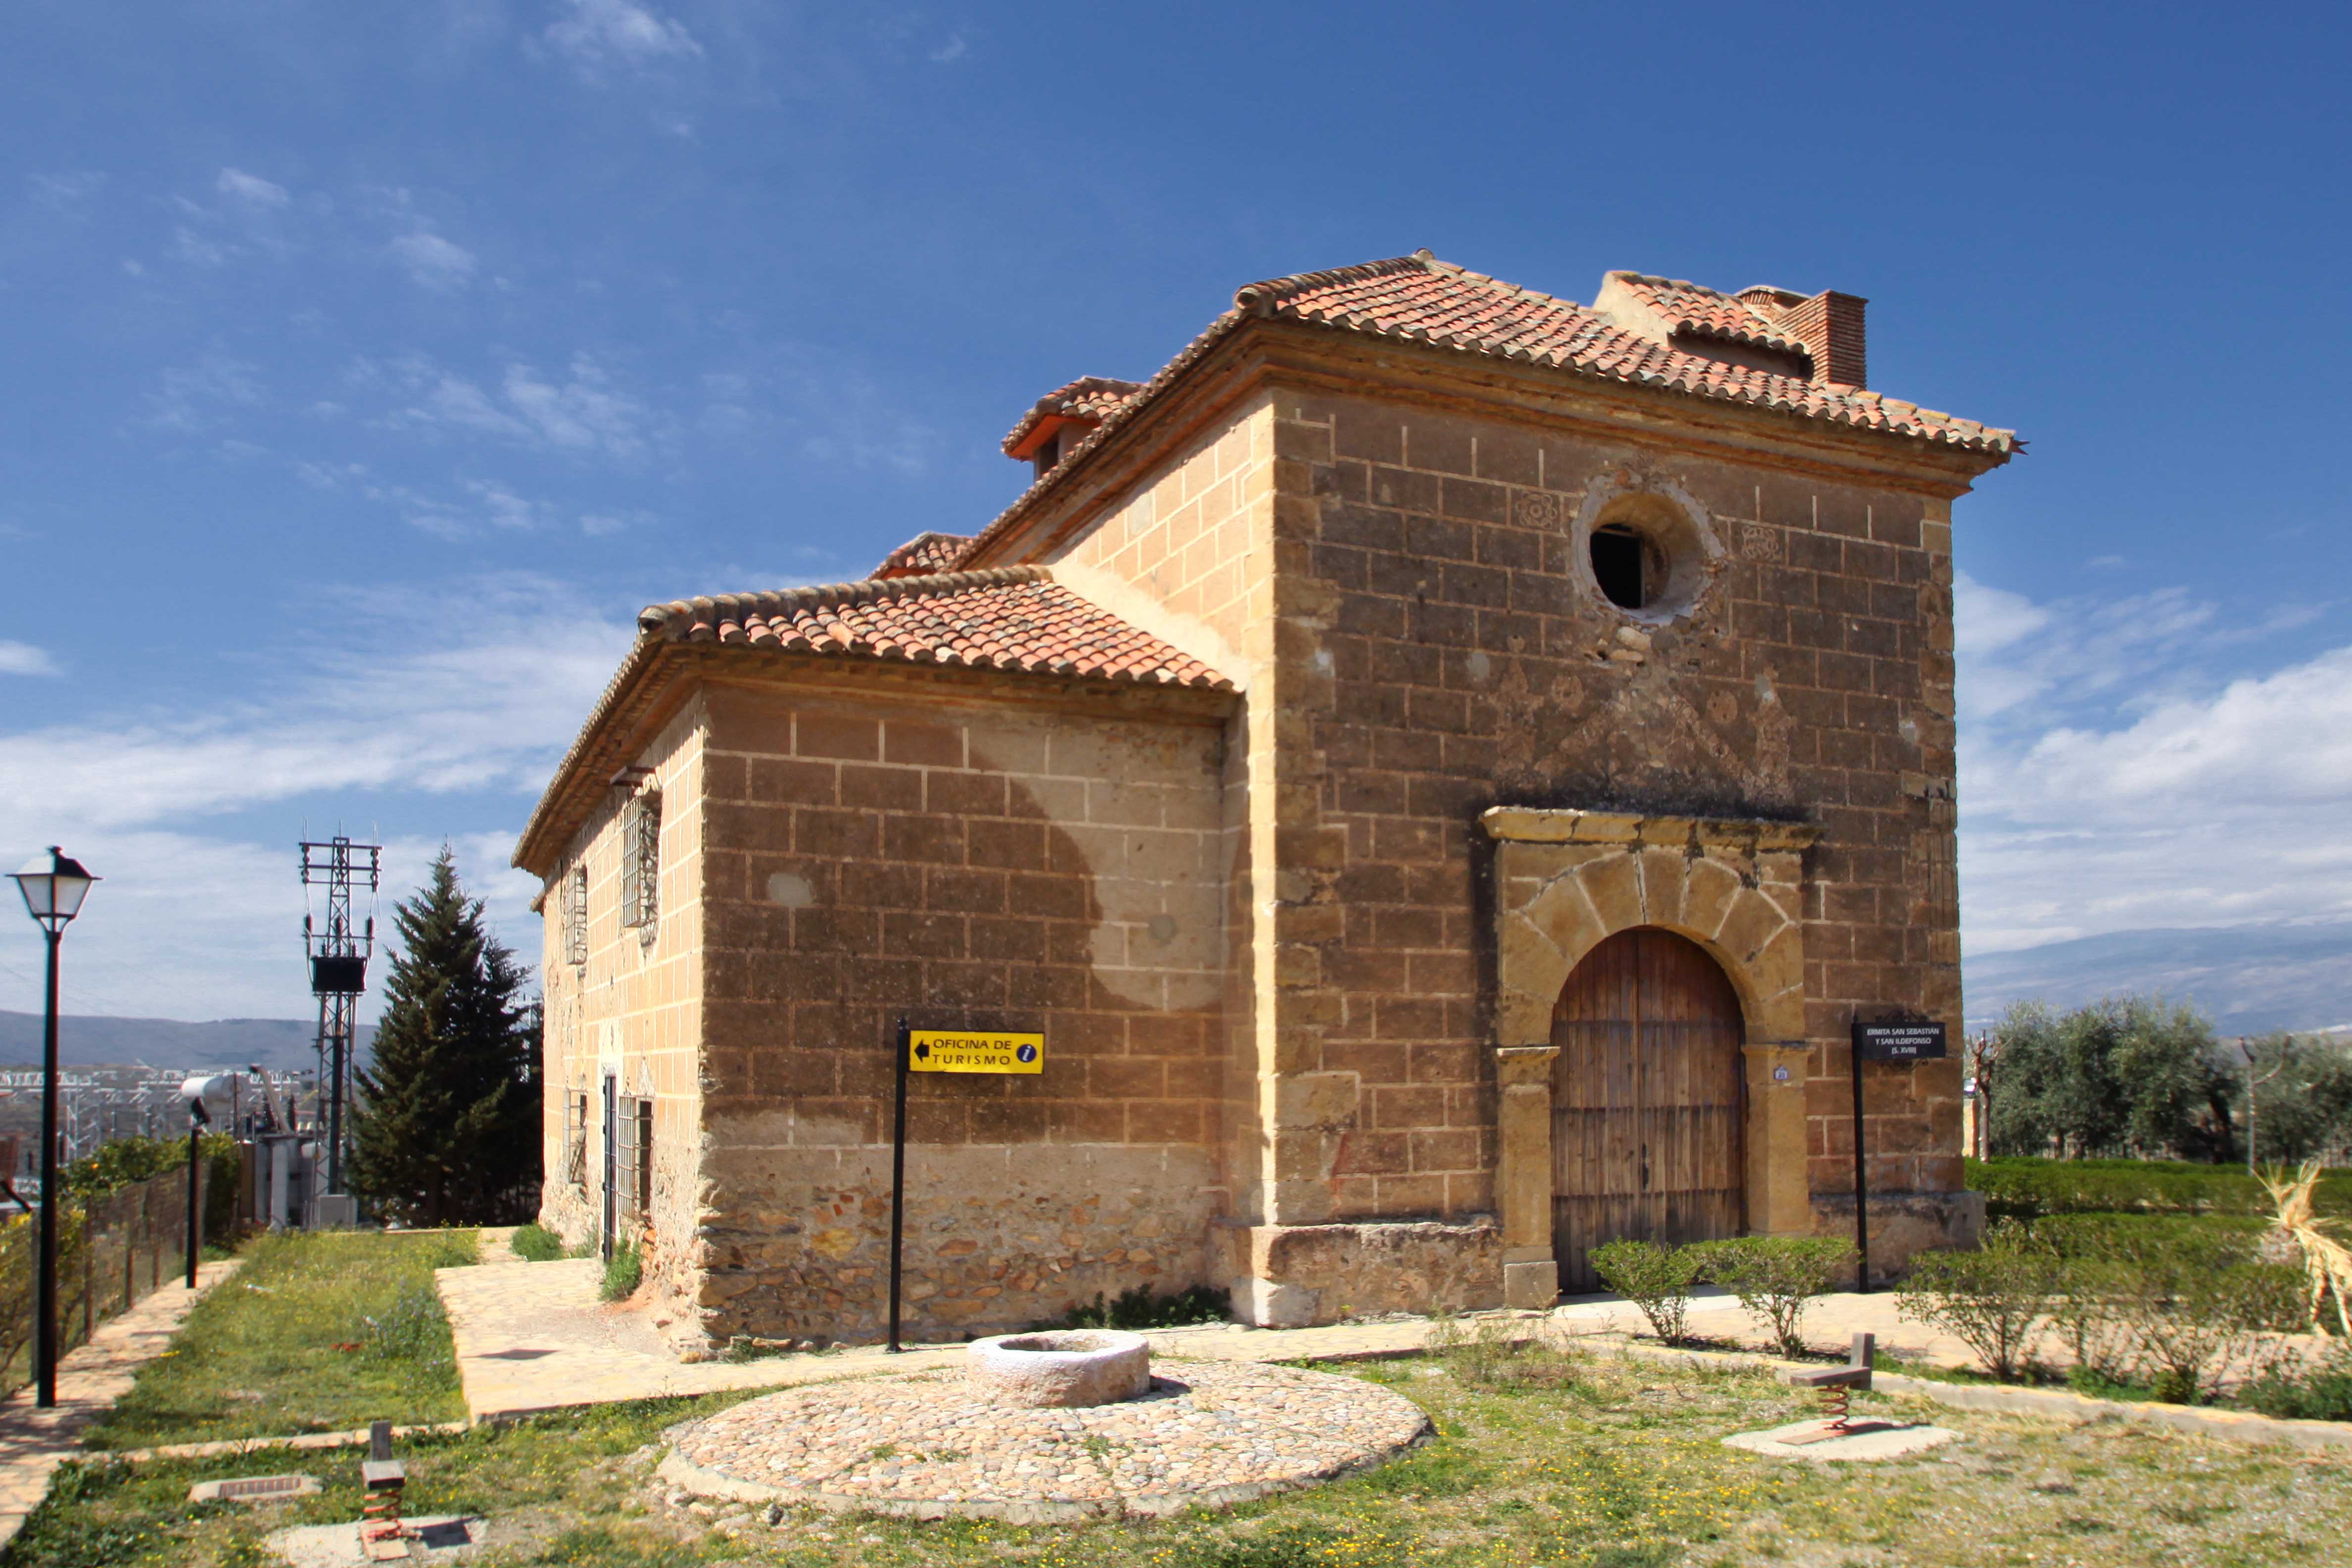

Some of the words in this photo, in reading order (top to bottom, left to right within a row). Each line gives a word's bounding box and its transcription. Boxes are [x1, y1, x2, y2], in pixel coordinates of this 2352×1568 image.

[933, 1039, 988, 1049] OFICINA
[994, 1040, 1012, 1050] DE
[932, 1054, 1010, 1065] TURISMO
